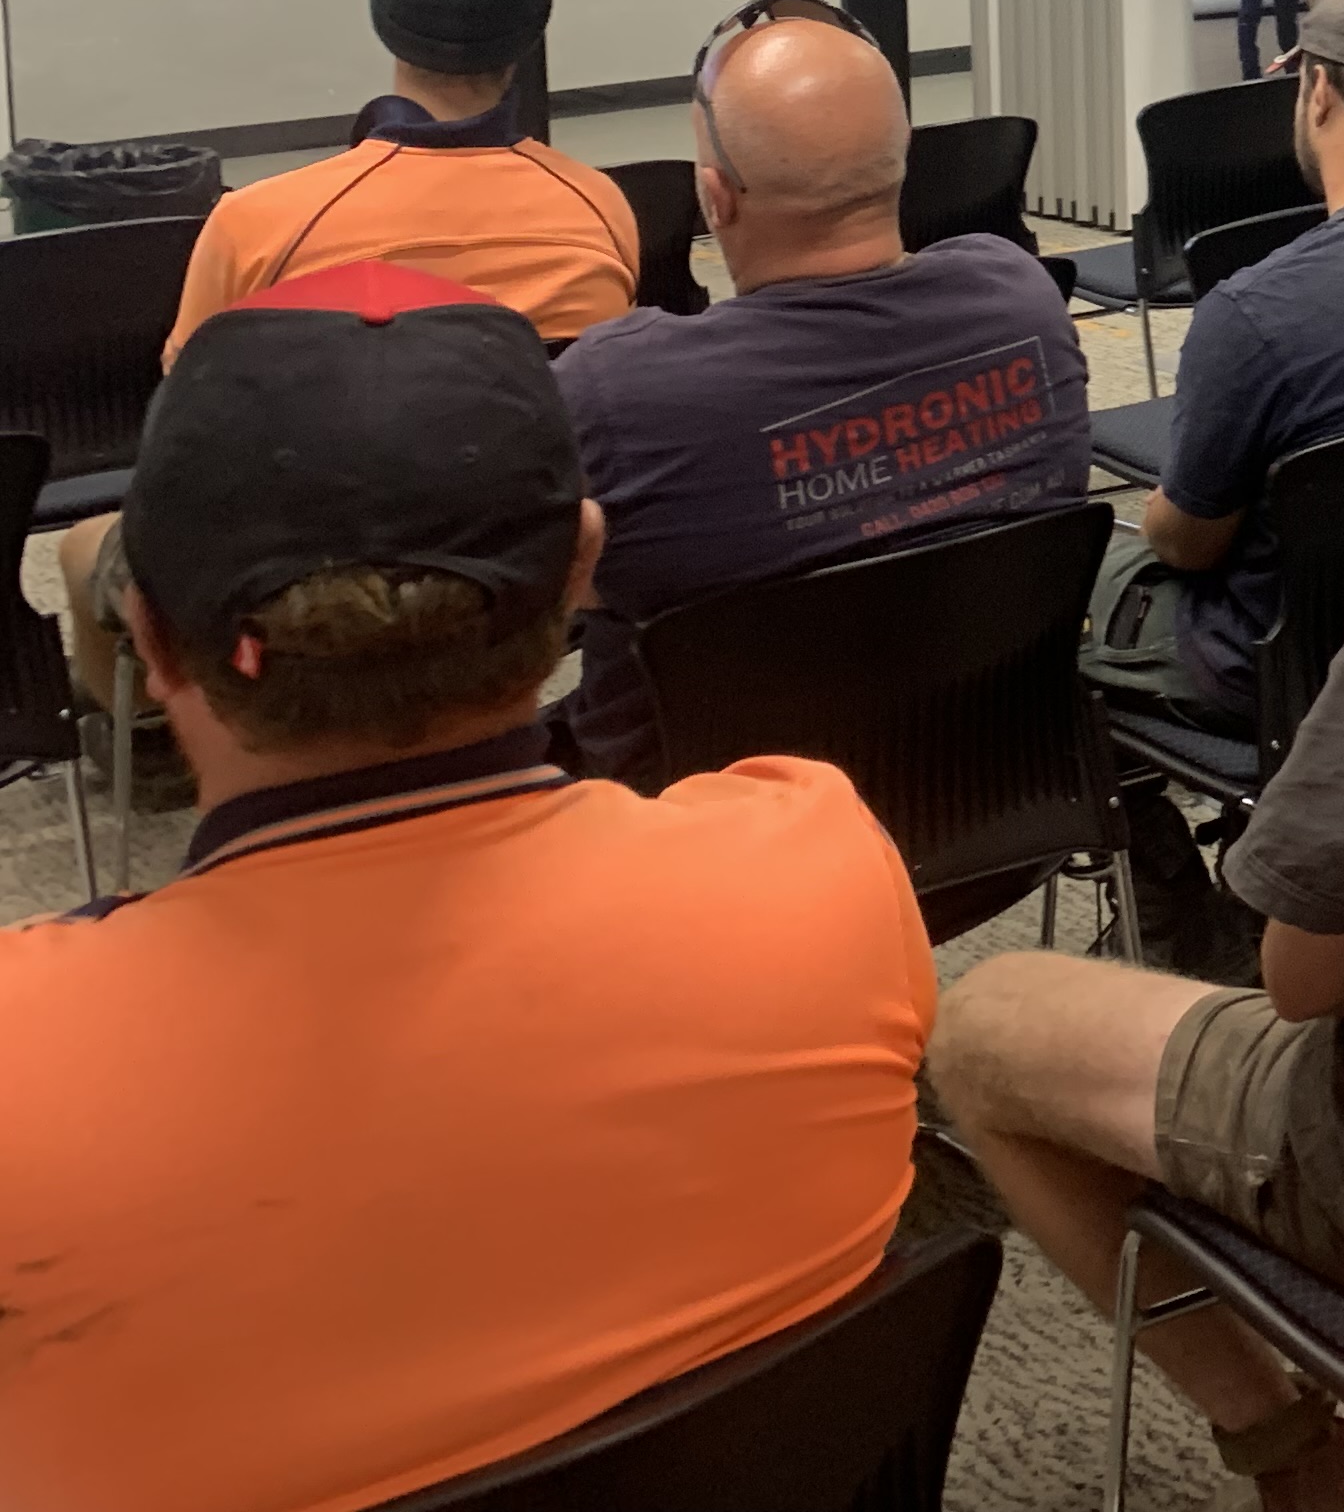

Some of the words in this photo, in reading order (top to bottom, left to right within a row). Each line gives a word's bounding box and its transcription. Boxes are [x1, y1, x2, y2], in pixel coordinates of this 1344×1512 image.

[770, 356, 1038, 480] HYDRONIC
[778, 454, 894, 510] HOME
[895, 397, 1043, 474] HEATING
